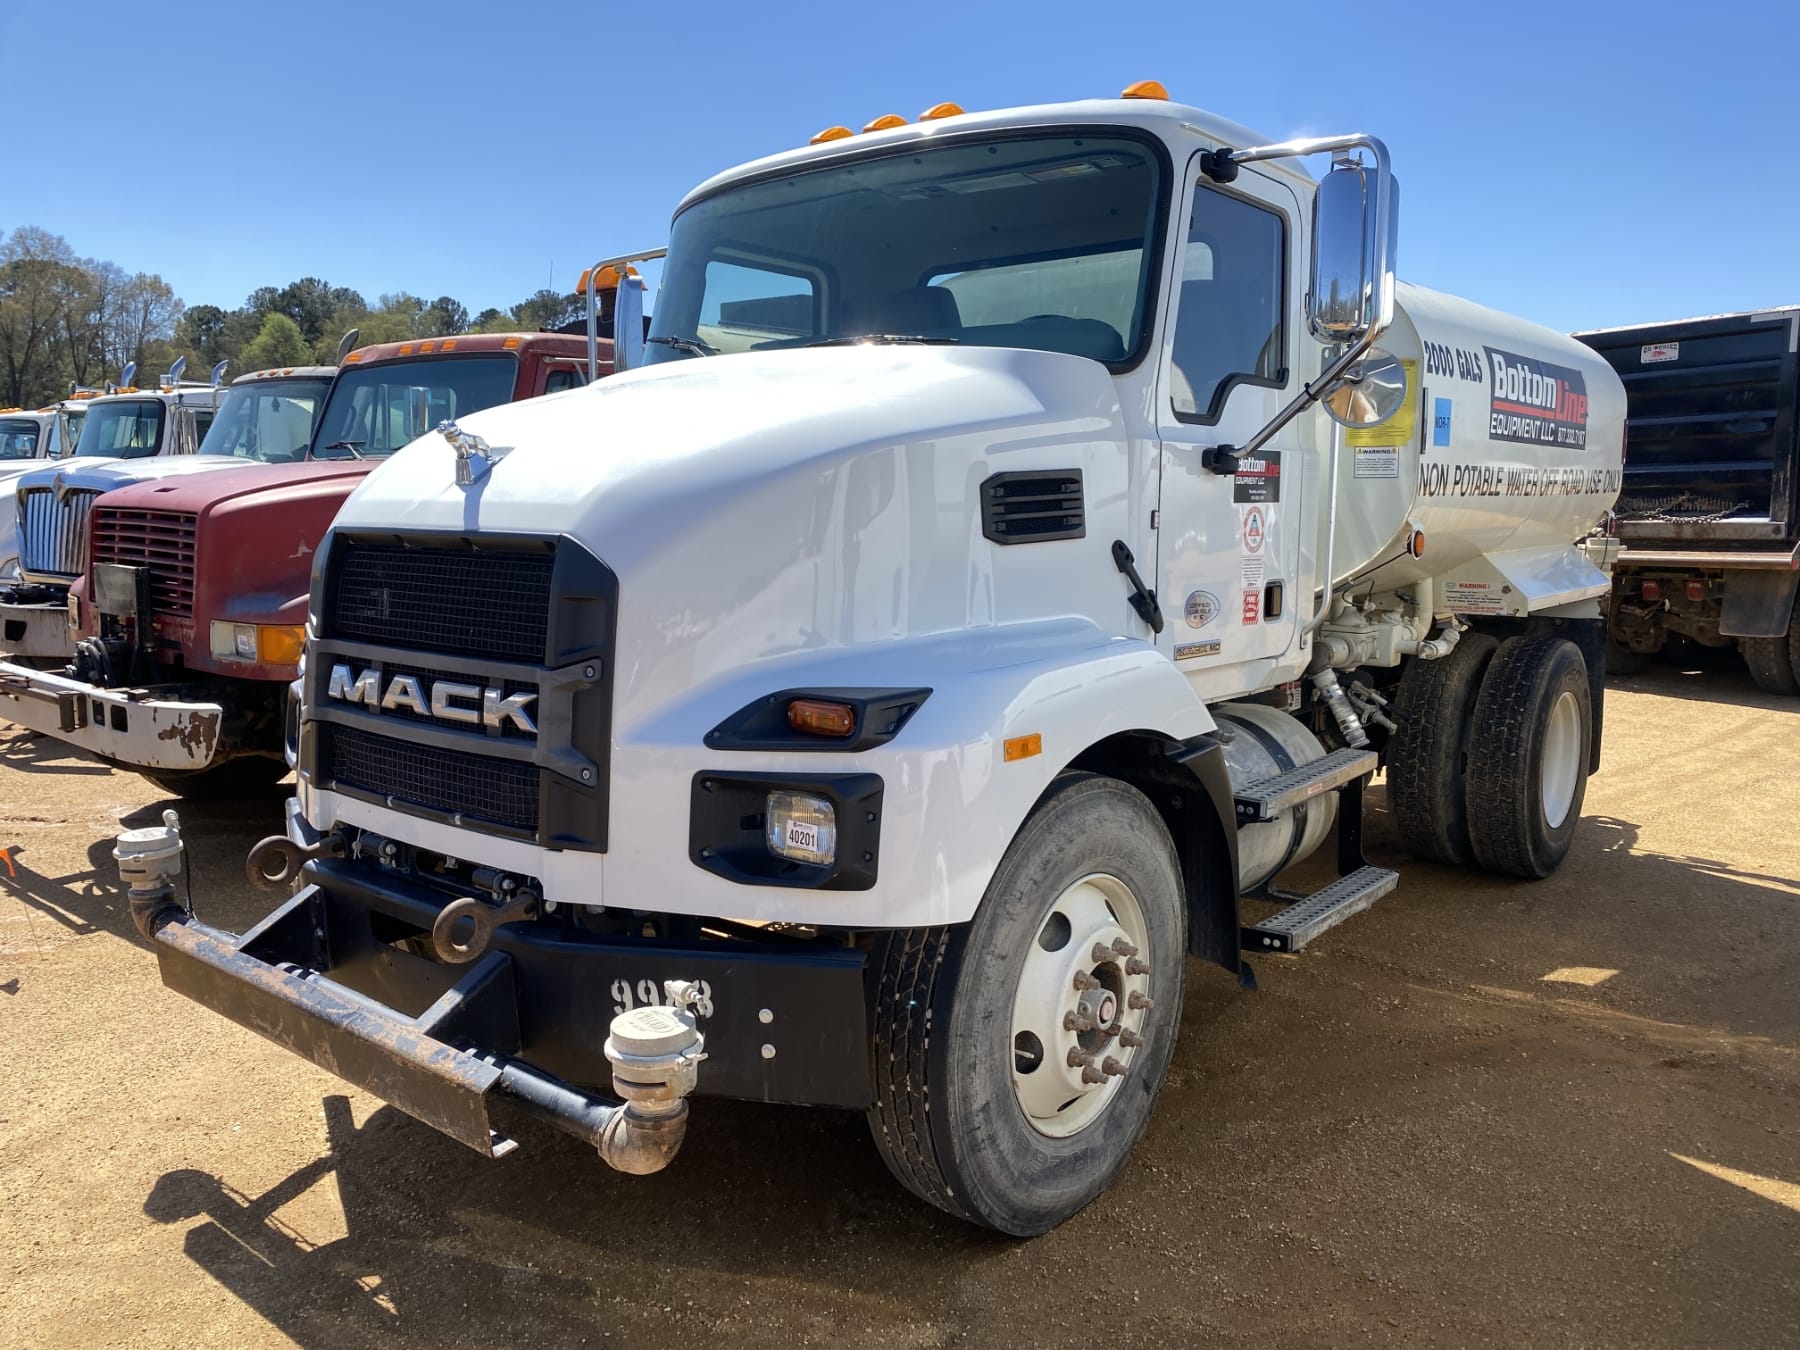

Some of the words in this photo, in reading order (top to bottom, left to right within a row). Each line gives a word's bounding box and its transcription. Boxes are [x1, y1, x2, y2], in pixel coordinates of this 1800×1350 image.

[1423, 340, 1455, 378] 2000
[1455, 348, 1483, 384] GALS
[1490, 413, 1540, 439] EQUIPMENT
[1540, 421, 1555, 441] LLC
[1418, 463, 1450, 497] NON
[1451, 464, 1504, 497] POTABLE
[1505, 467, 1540, 497] WATER
[1540, 468, 1560, 497] OFF
[1559, 468, 1584, 496] ROAD
[1585, 469, 1602, 494] USE
[1603, 469, 1622, 493] ONLY
[328, 664, 538, 733] MACK
[788, 829, 815, 847] 40201
